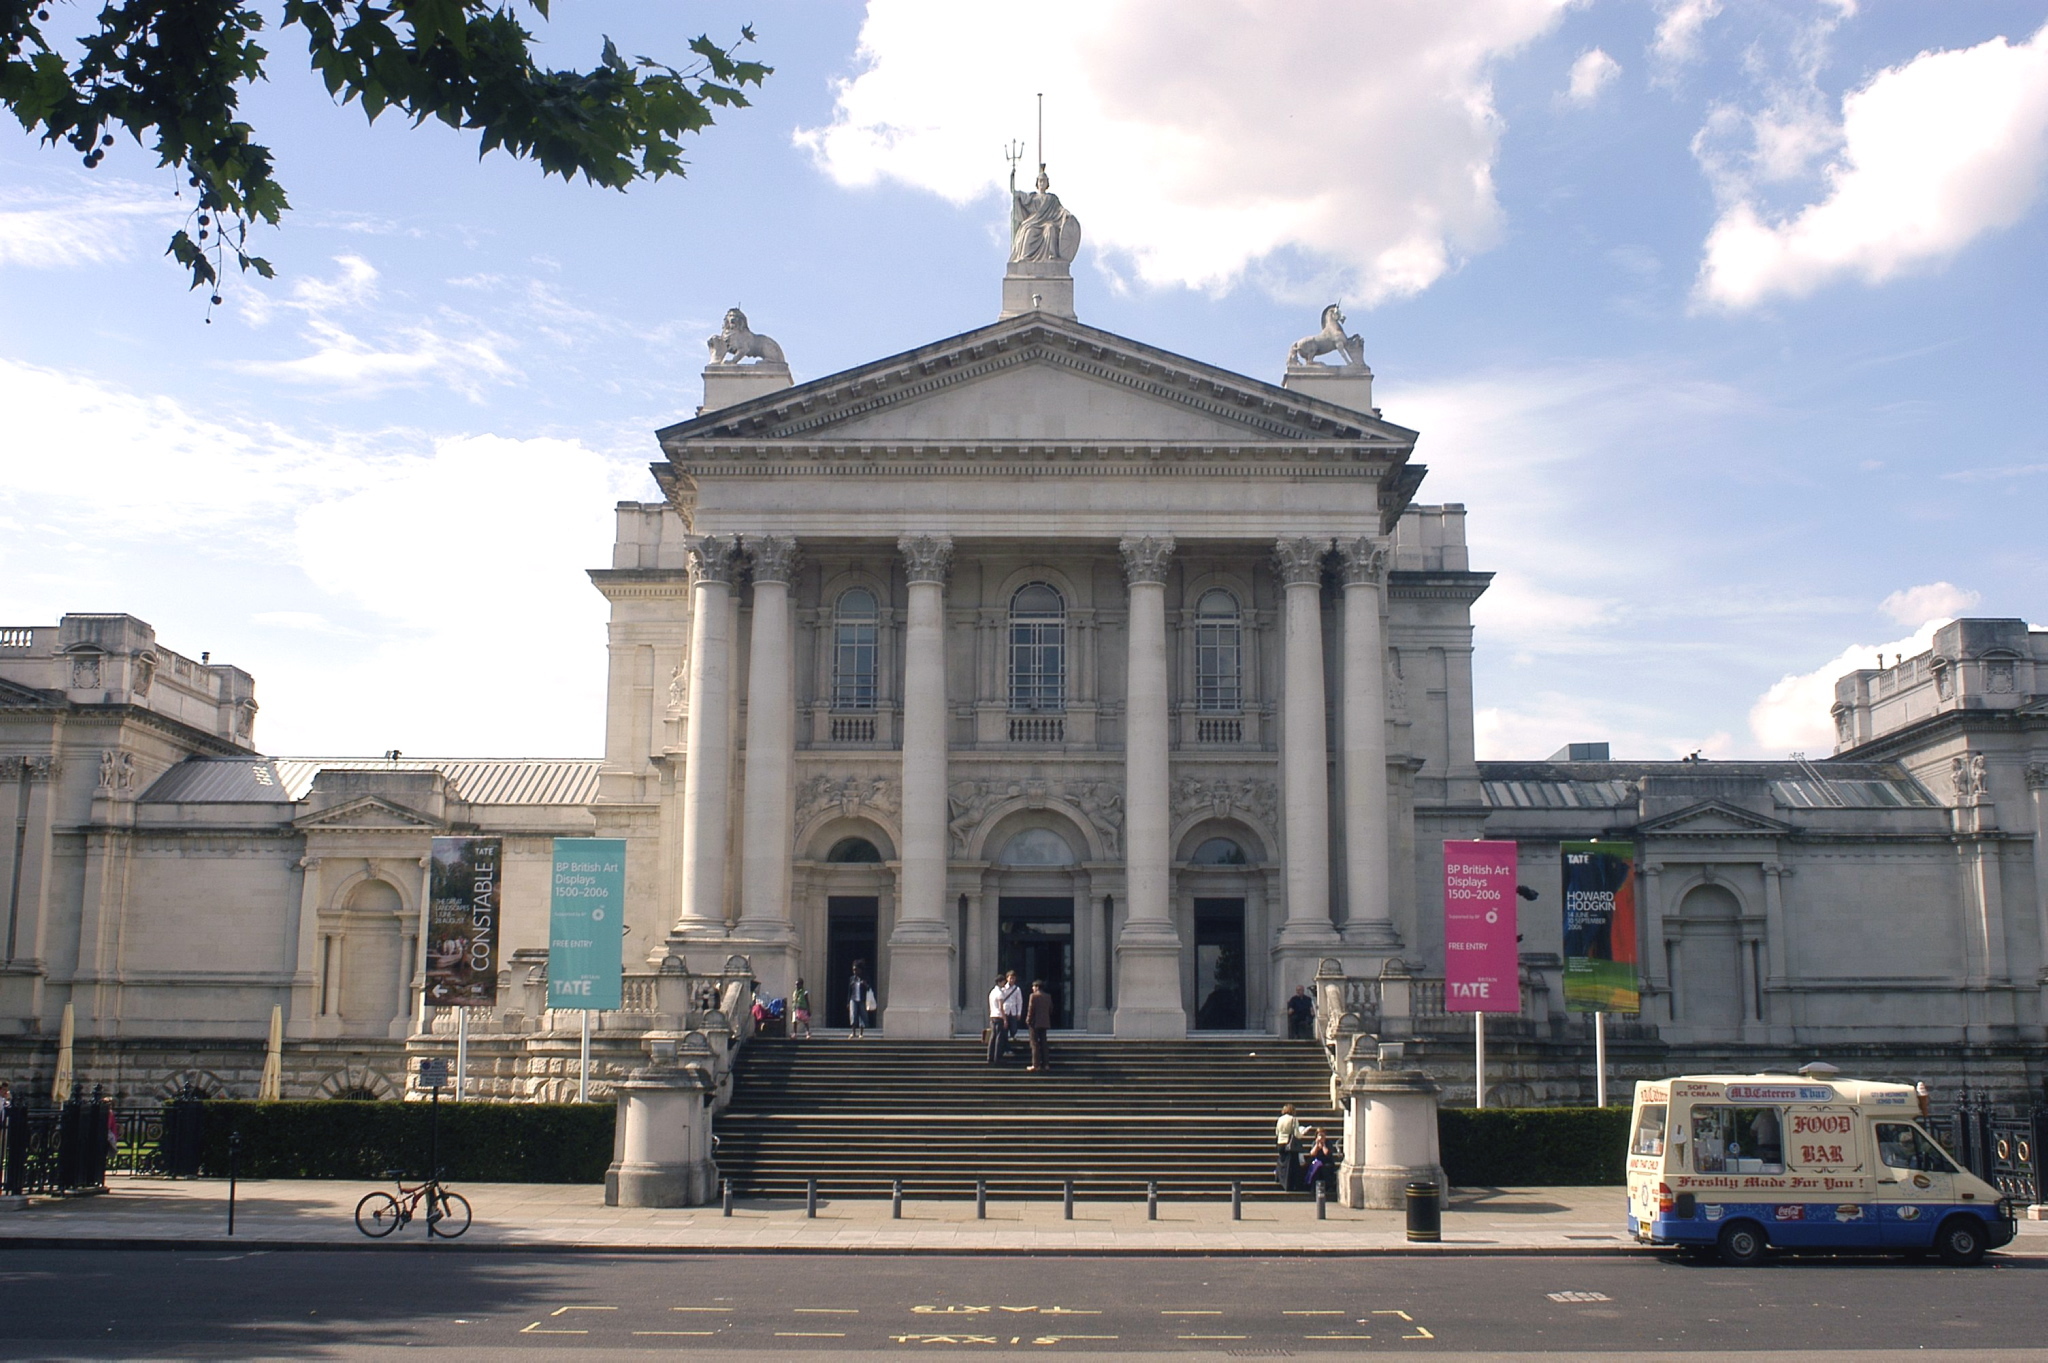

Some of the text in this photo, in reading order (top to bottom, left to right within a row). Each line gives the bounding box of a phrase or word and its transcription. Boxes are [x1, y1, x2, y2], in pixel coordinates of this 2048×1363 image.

[475, 848, 494, 856] TATE
[1567, 854, 1590, 864] TATE
[556, 862, 618, 872] BP British Art
[1447, 864, 1510, 875] BP British Art
[556, 874, 596, 886] Displays
[1448, 876, 1488, 888] Displays
[1567, 890, 1614, 901] HOWARD
[1567, 901, 1616, 911] HODGKIN
[471, 862, 493, 971] CONSTABLE
[552, 940, 592, 948] FREE ENTRY
[1448, 942, 1488, 950] FREE ENTRY
[554, 980, 592, 996] TATE
[1451, 983, 1490, 998] TATE
[1793, 1116, 1850, 1134] FOOD
[1801, 1145, 1844, 1162] BAR
[1677, 1177, 1738, 1189] Freshly
[1744, 1177, 1786, 1188] Made
[1790, 1177, 1818, 1188] For
[1824, 1178, 1854, 1190] You
[889, 1336, 1061, 1344] TAXIS
